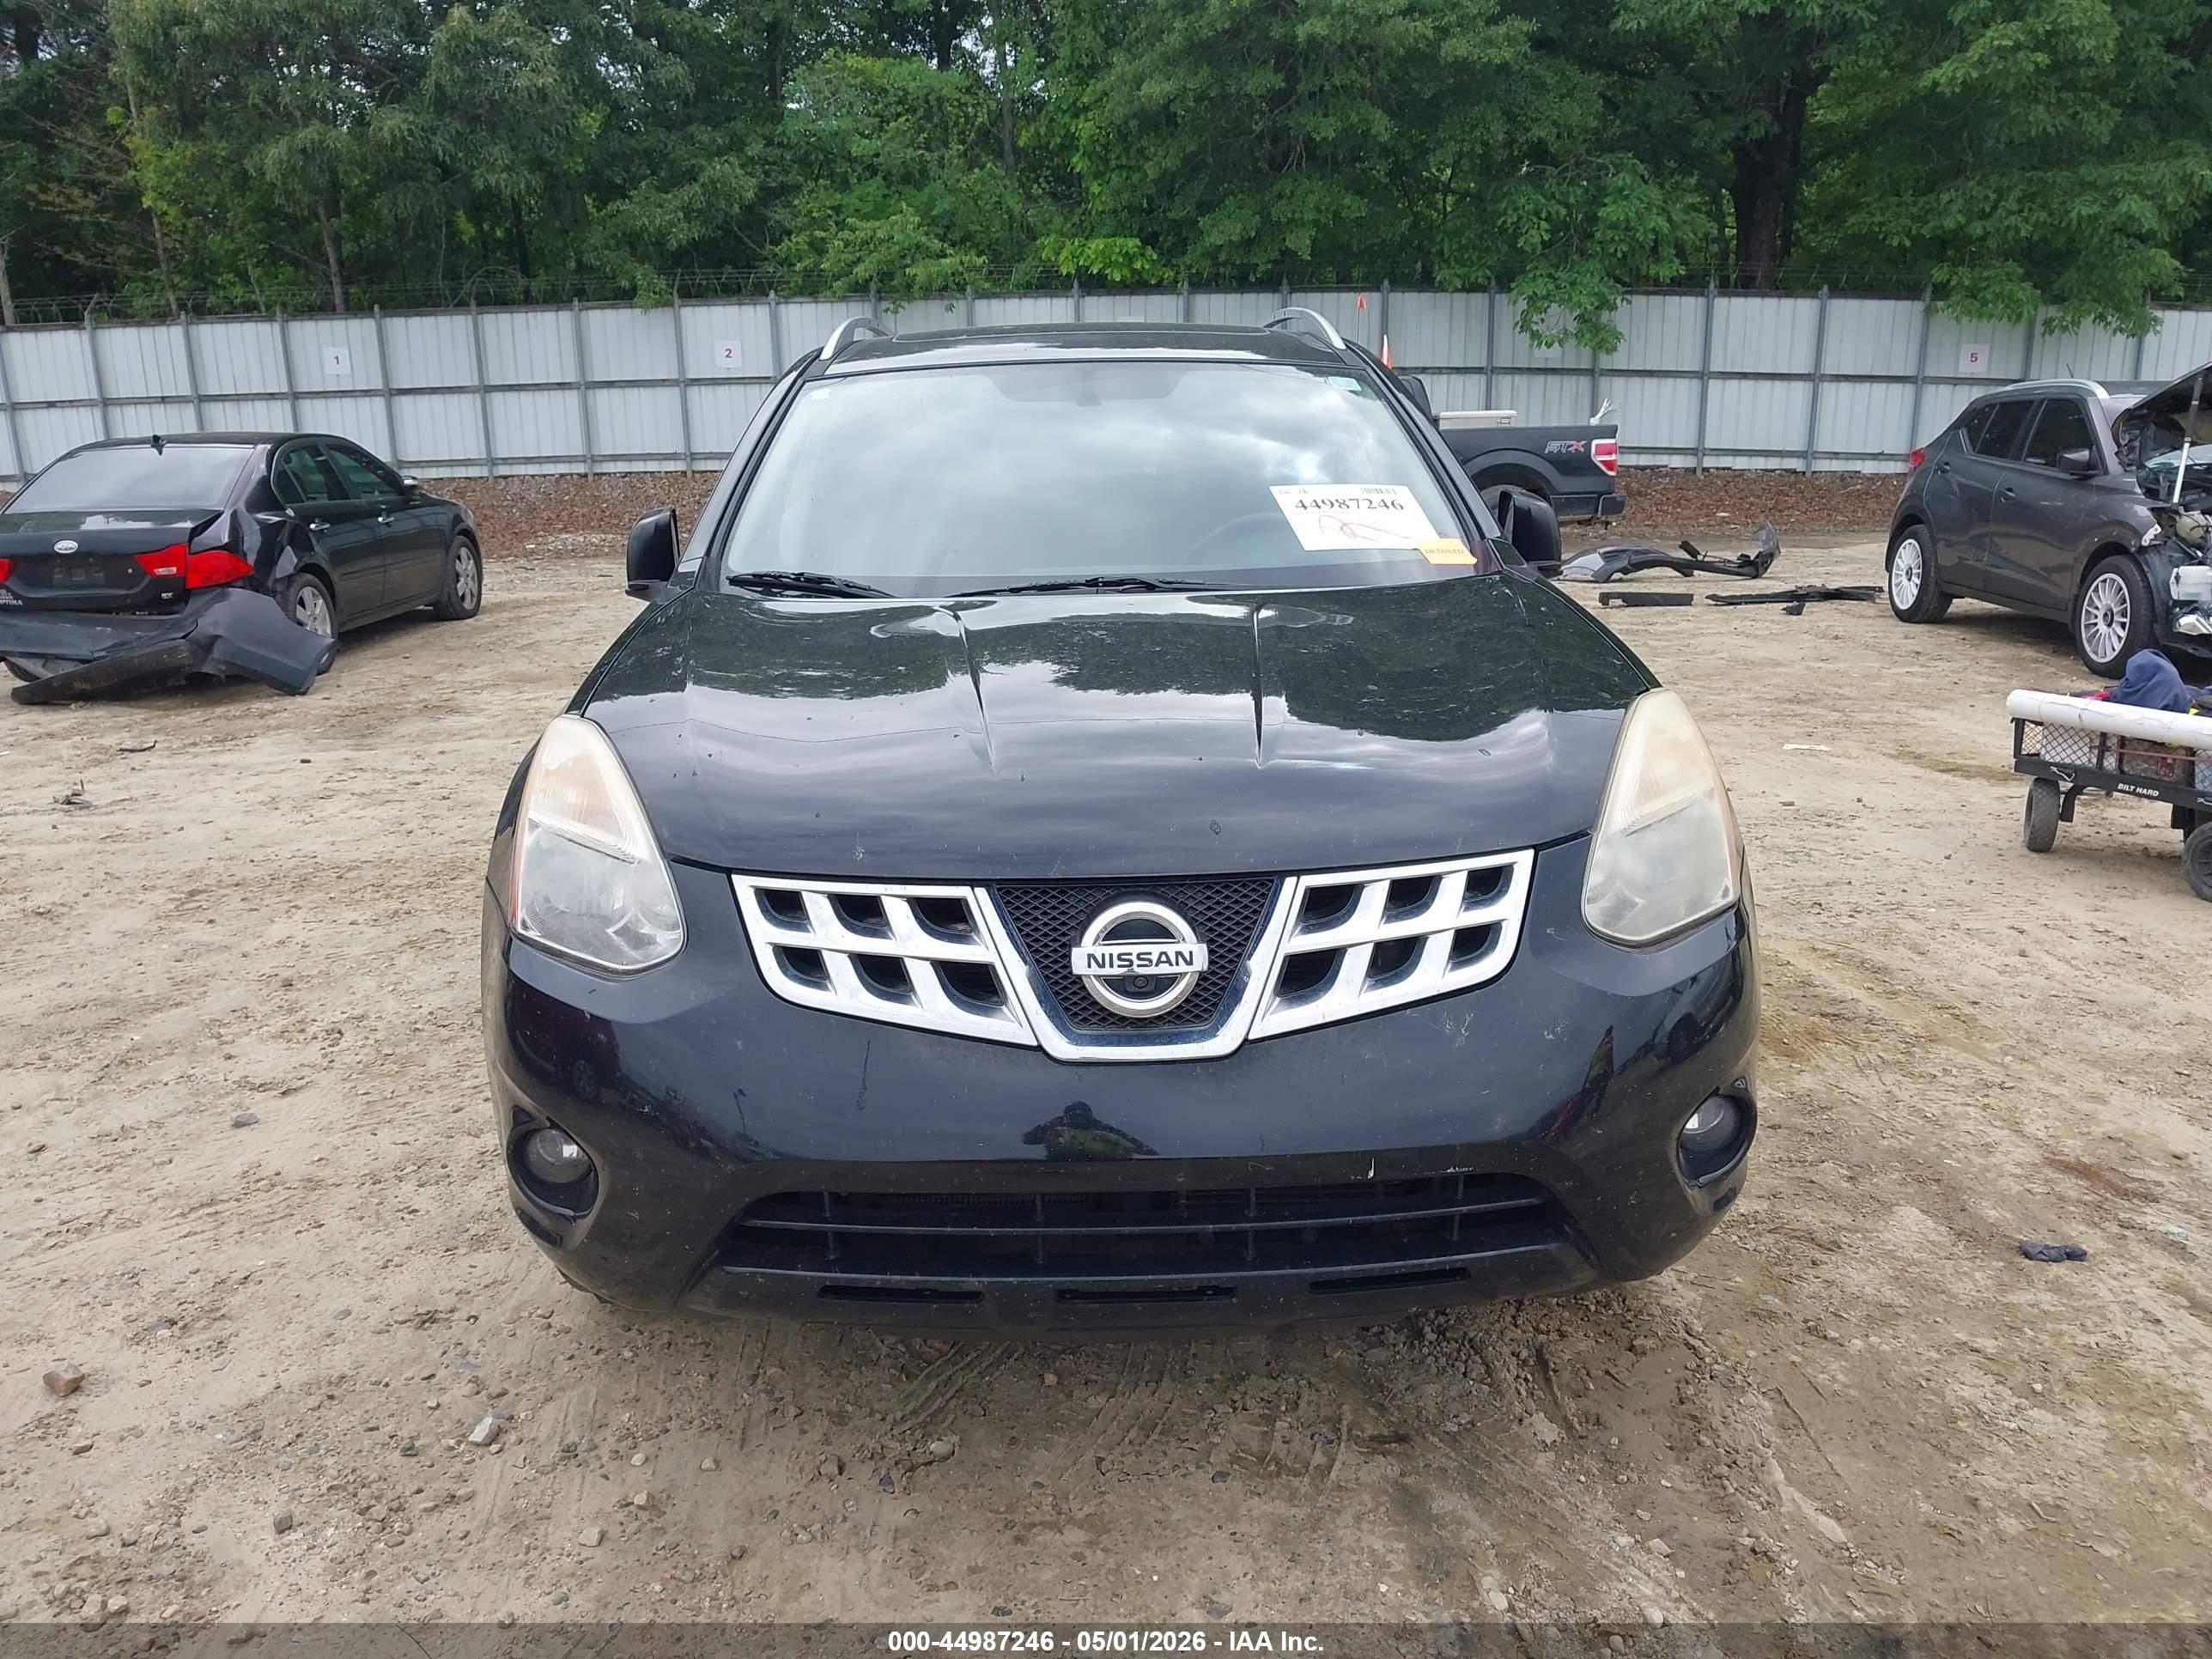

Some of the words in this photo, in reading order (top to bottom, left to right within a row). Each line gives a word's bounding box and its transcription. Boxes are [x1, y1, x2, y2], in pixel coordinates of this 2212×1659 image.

[725, 348, 732, 358] 2
[1970, 352, 1978, 362] 5
[334, 355, 340, 365] 1
[1545, 440, 1587, 453] STX
[1295, 497, 1405, 511] 44987246
[2117, 782, 2136, 792] BILT
[2136, 787, 2160, 797] HARD
[1086, 951, 1194, 969] NISSAN
